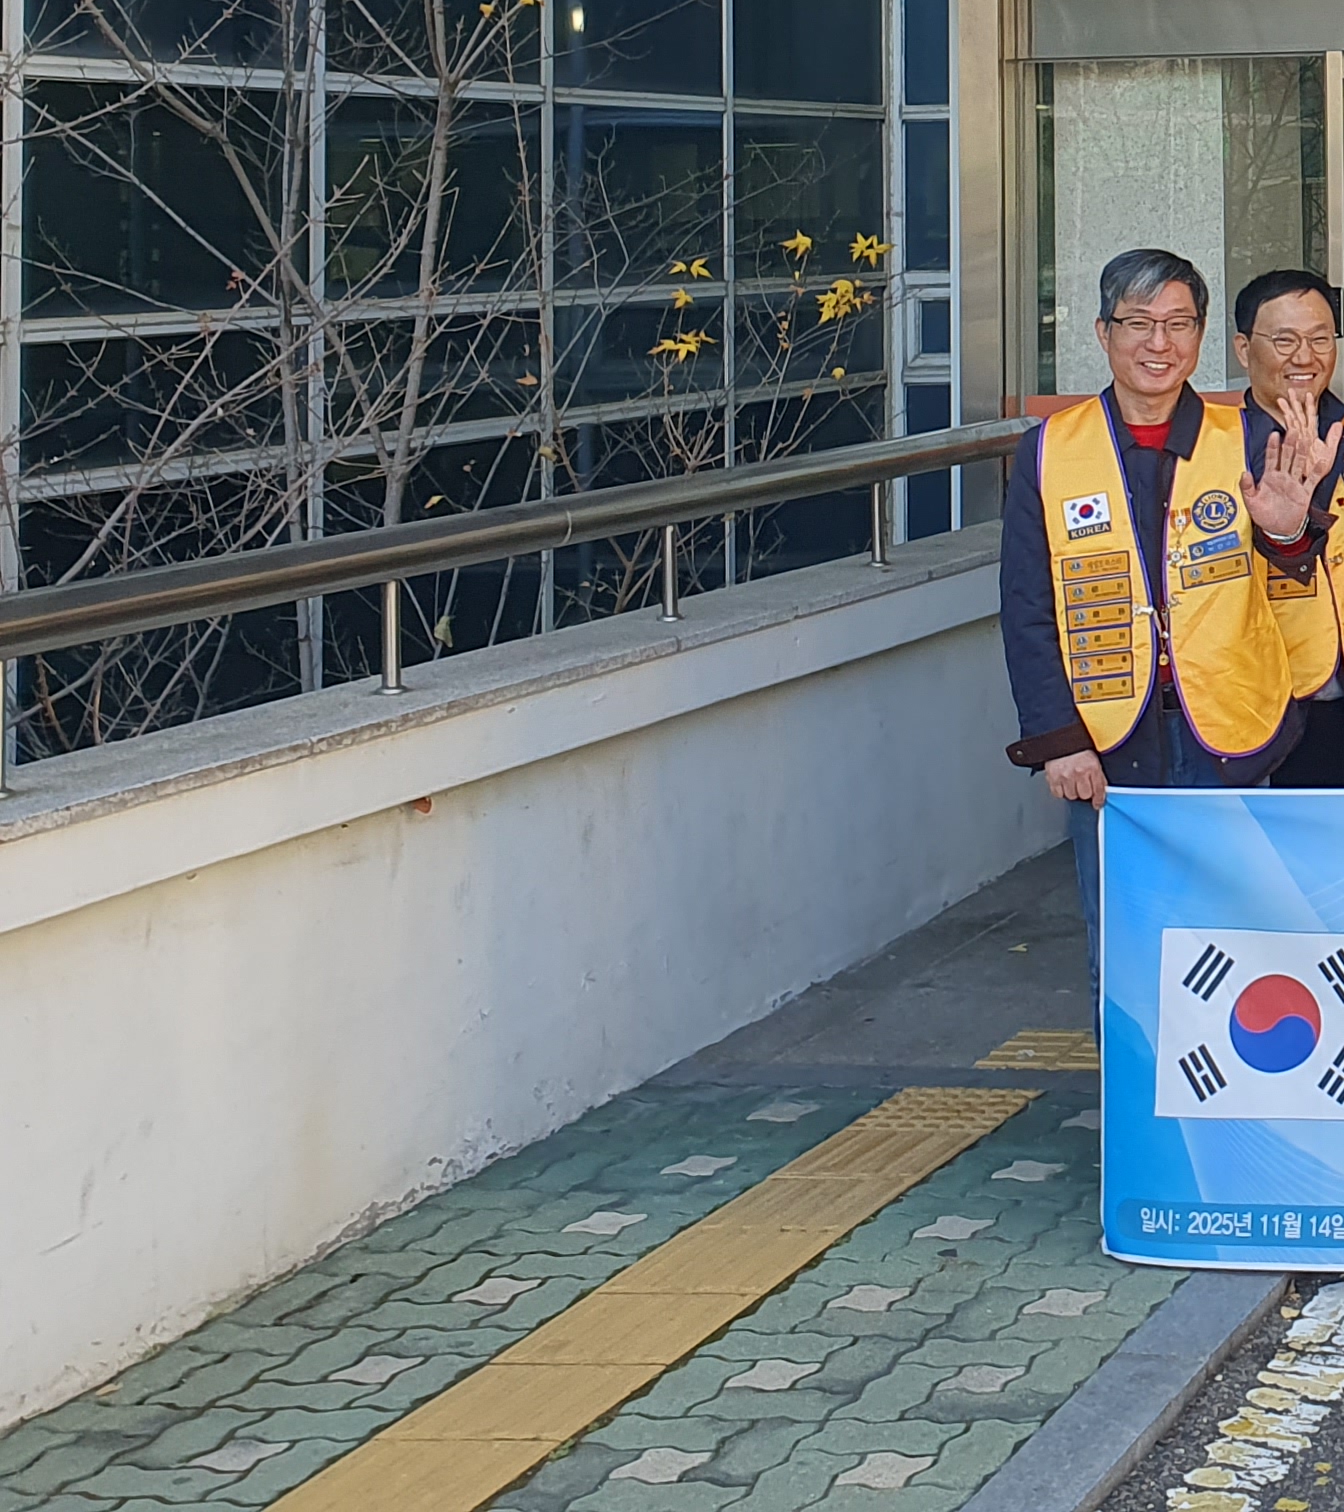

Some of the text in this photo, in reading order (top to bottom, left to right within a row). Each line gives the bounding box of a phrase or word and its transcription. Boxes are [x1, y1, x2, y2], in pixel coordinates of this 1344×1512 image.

[1071, 524, 1110, 539] KOREA
[1140, 1207, 1181, 1235] 일시:
[1188, 1211, 1252, 1238] 2025년
[1260, 1212, 1301, 1239] 11월
